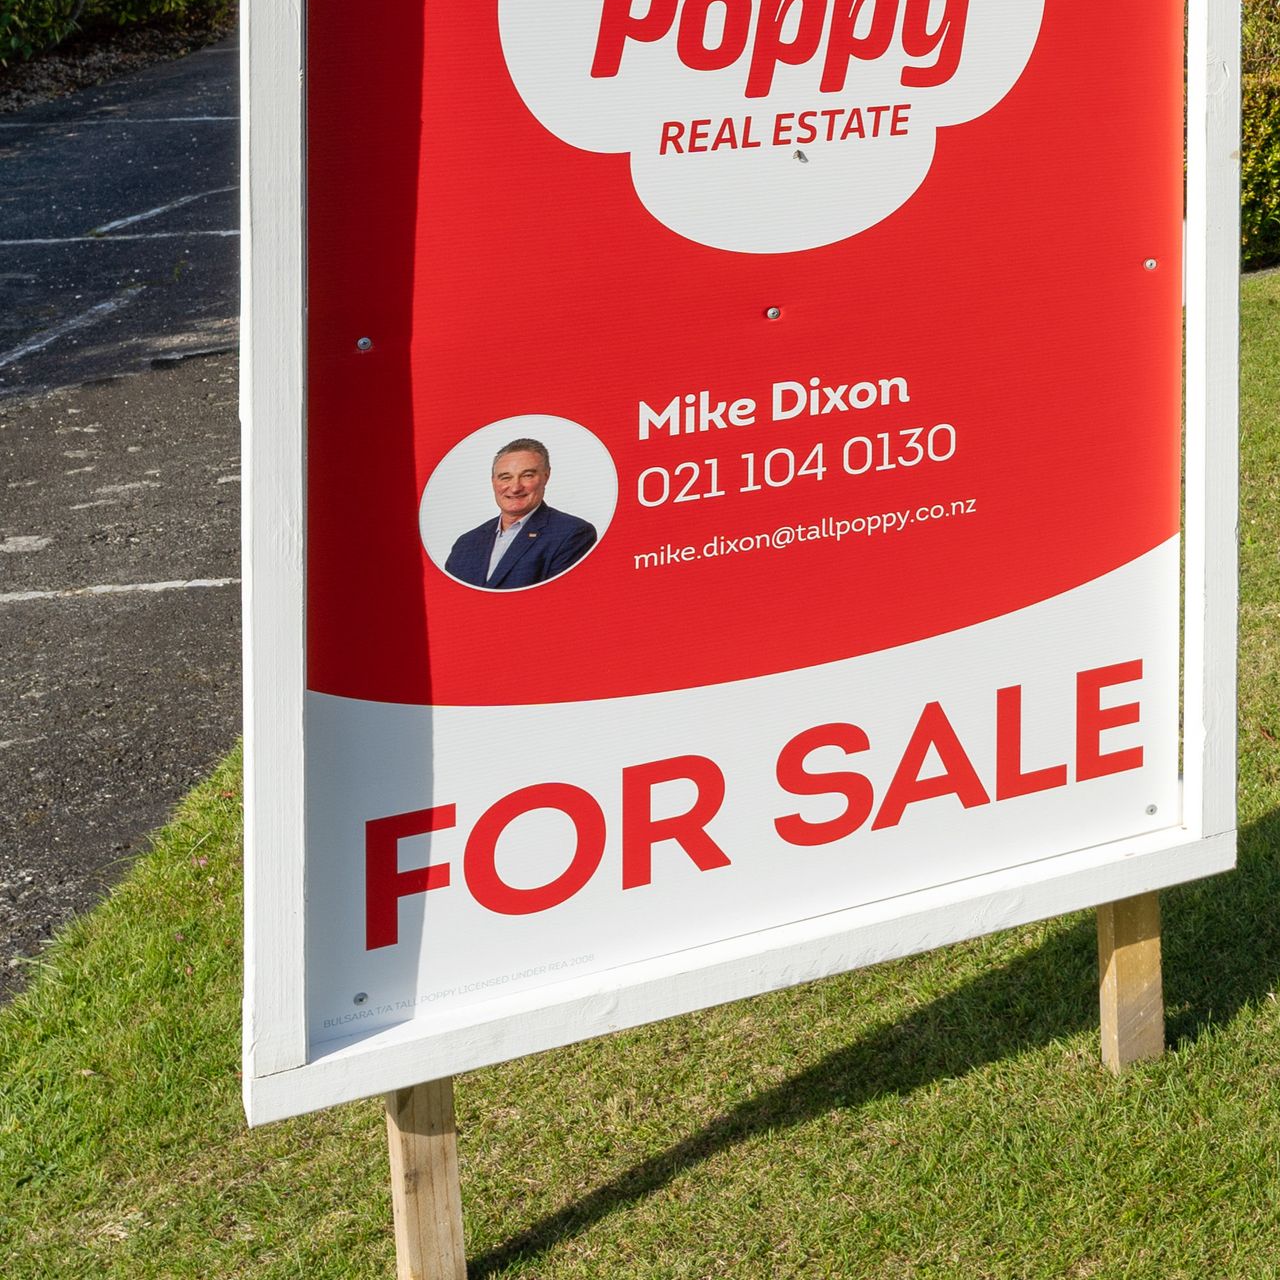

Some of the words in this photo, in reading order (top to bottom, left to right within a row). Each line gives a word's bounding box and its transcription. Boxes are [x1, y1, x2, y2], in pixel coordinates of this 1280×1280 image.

[659, 116, 761, 155] REAL
[771, 104, 912, 145] ESTATE
[638, 389, 756, 441] Mike
[771, 375, 910, 421] Dixon
[637, 458, 725, 508] 021
[740, 442, 826, 492] 104
[842, 423, 957, 475] 0130
[633, 498, 977, 570] mike.dixon@tallpoppy.co.nz
[366, 753, 731, 951] FOR
[773, 658, 1143, 847] SALE
[323, 1008, 374, 1028] BULSARA
[376, 1004, 394, 1016] T/A
[395, 997, 417, 1010] TALL
[420, 988, 457, 1002] POPPY
[458, 974, 510, 994] LICENSED
[511, 965, 547, 981] UNDER
[548, 960, 569, 972] REA
[570, 953, 595, 966] 2008
